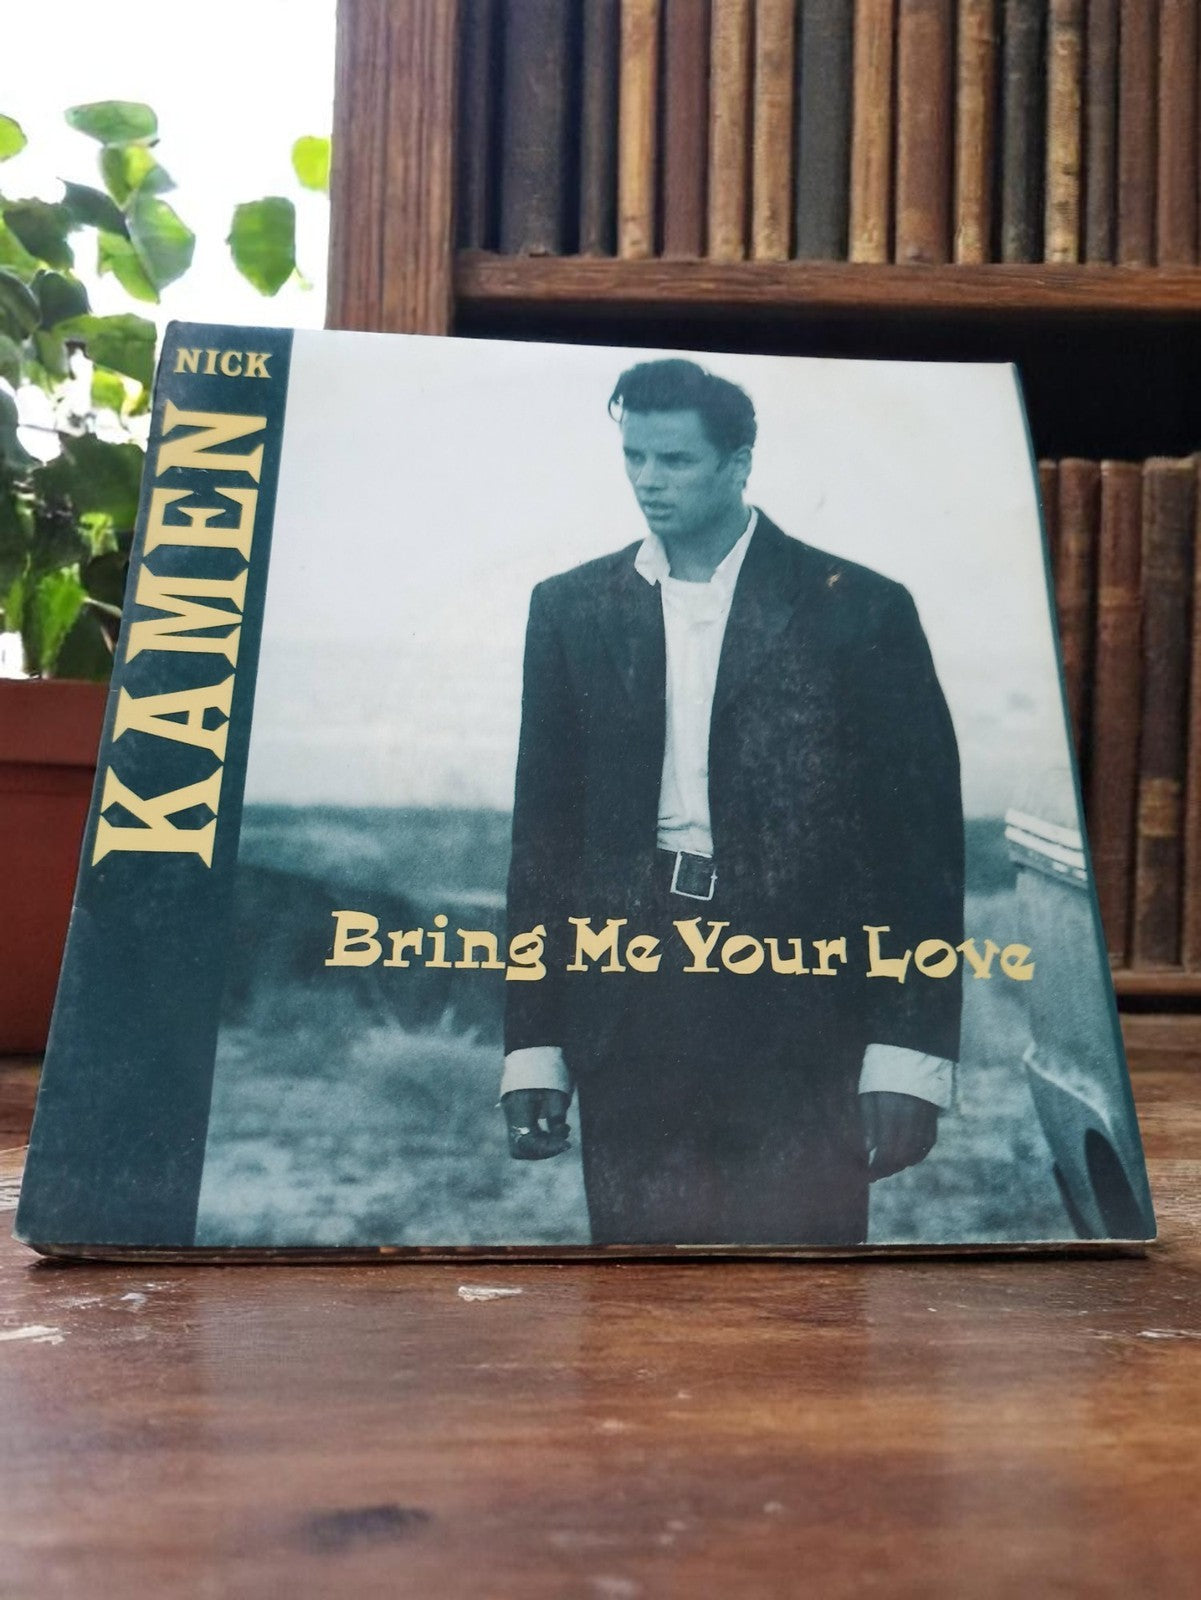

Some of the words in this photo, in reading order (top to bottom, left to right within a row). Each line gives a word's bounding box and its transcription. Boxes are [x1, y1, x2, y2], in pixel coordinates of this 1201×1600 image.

[175, 348, 273, 379] NICK
[92, 401, 268, 867] KAMEN
[324, 909, 547, 982] Bring
[566, 917, 661, 974] Me
[673, 918, 848, 977] Your
[863, 925, 1035, 984] Love
